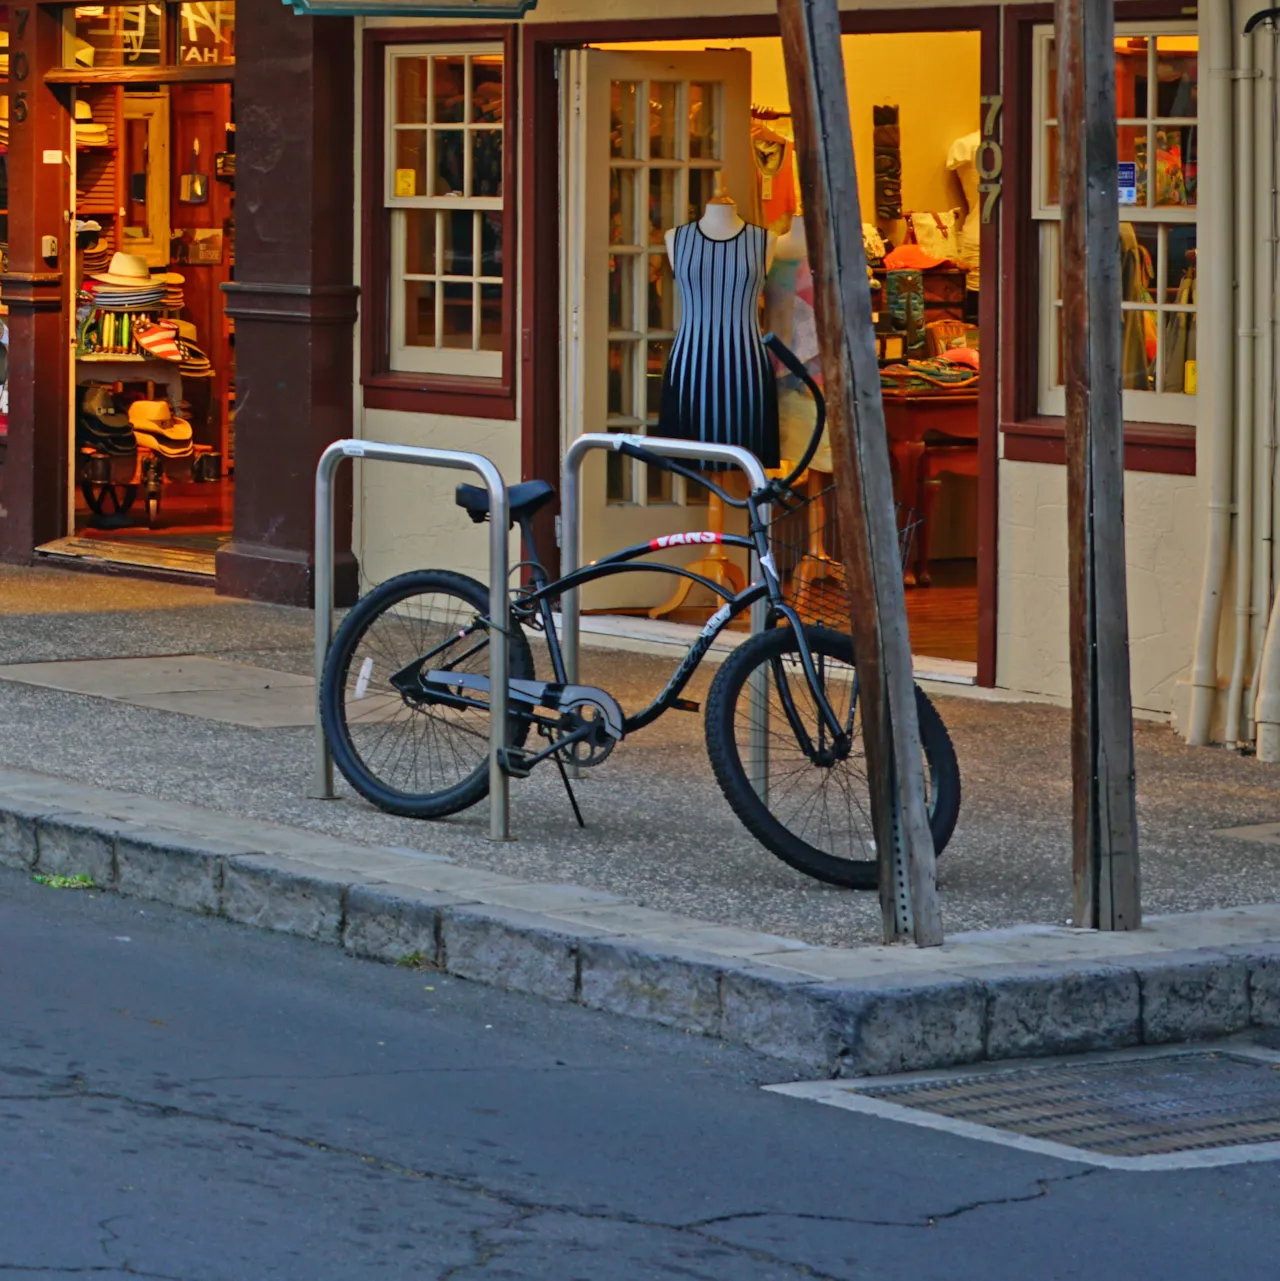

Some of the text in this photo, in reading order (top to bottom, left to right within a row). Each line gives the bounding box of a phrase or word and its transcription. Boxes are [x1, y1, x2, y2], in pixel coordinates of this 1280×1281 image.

[13, 8, 30, 122] 705
[975, 95, 1002, 224] 707
[657, 531, 716, 547] VANS
